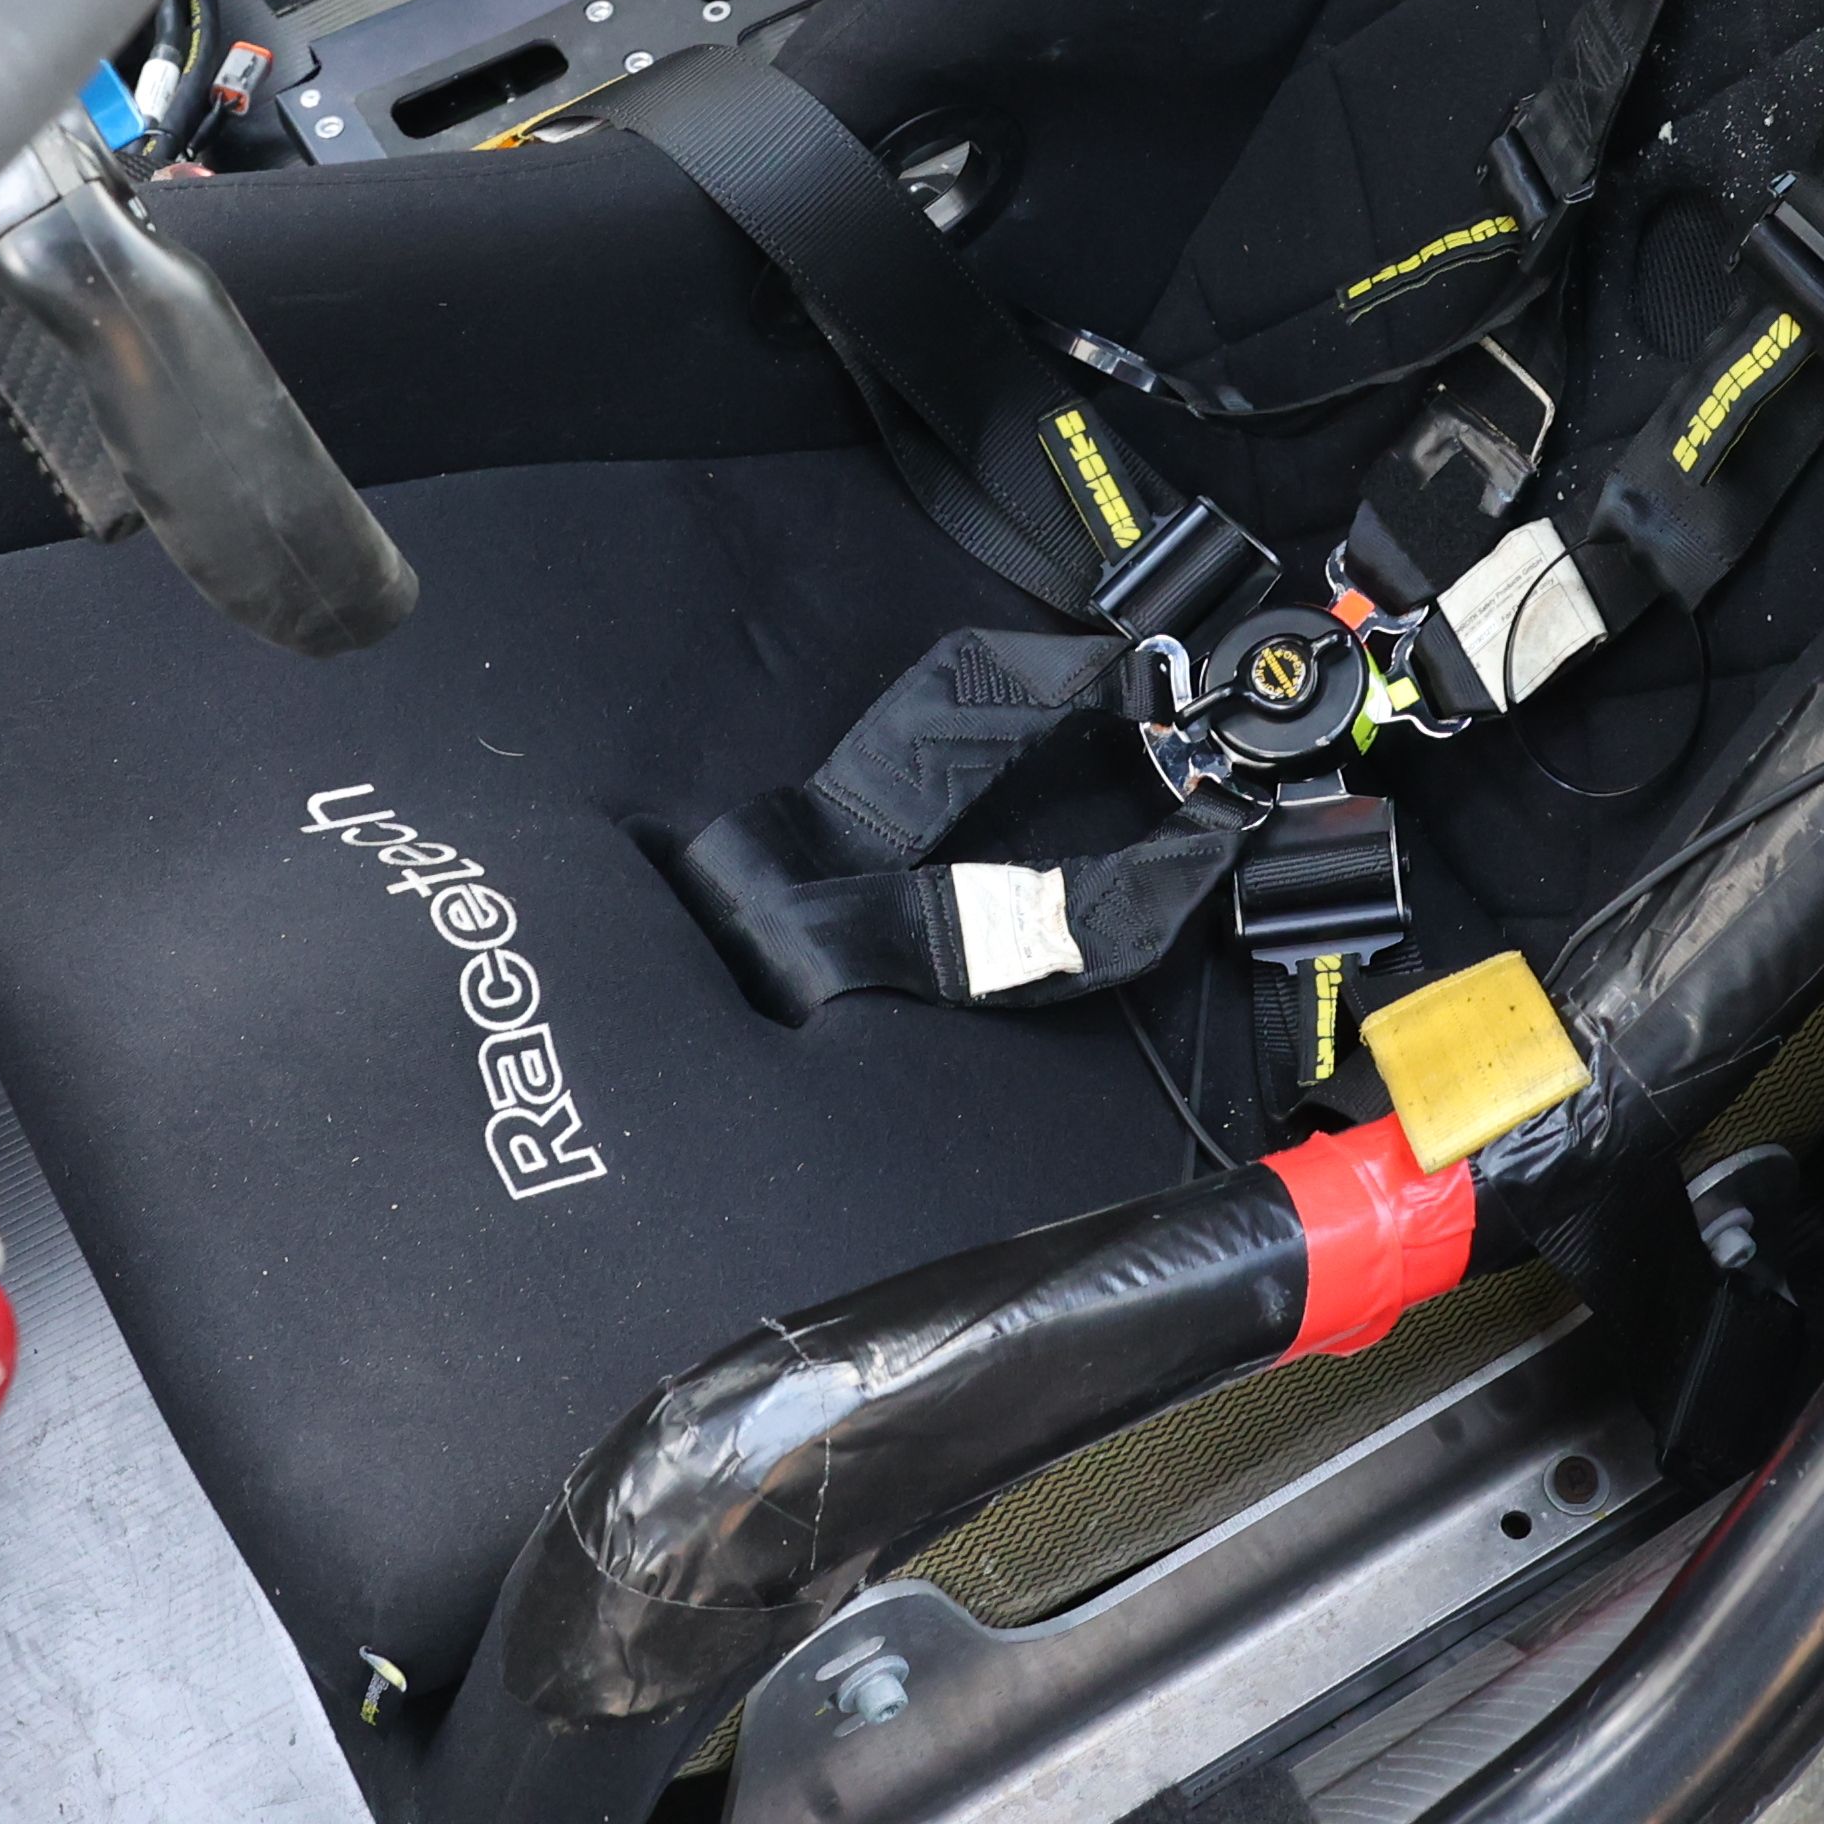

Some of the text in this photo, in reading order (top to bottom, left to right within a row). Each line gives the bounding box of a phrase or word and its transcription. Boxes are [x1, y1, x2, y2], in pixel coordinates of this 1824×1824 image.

[1671, 312, 1802, 473] SCHROTH
[1477, 597, 1496, 615] Safety
[1494, 574, 1522, 598] Products
[1261, 647, 1297, 698] SCHROTH
[1282, 650, 1302, 676] OPEN
[301, 783, 608, 1200] Racetech
